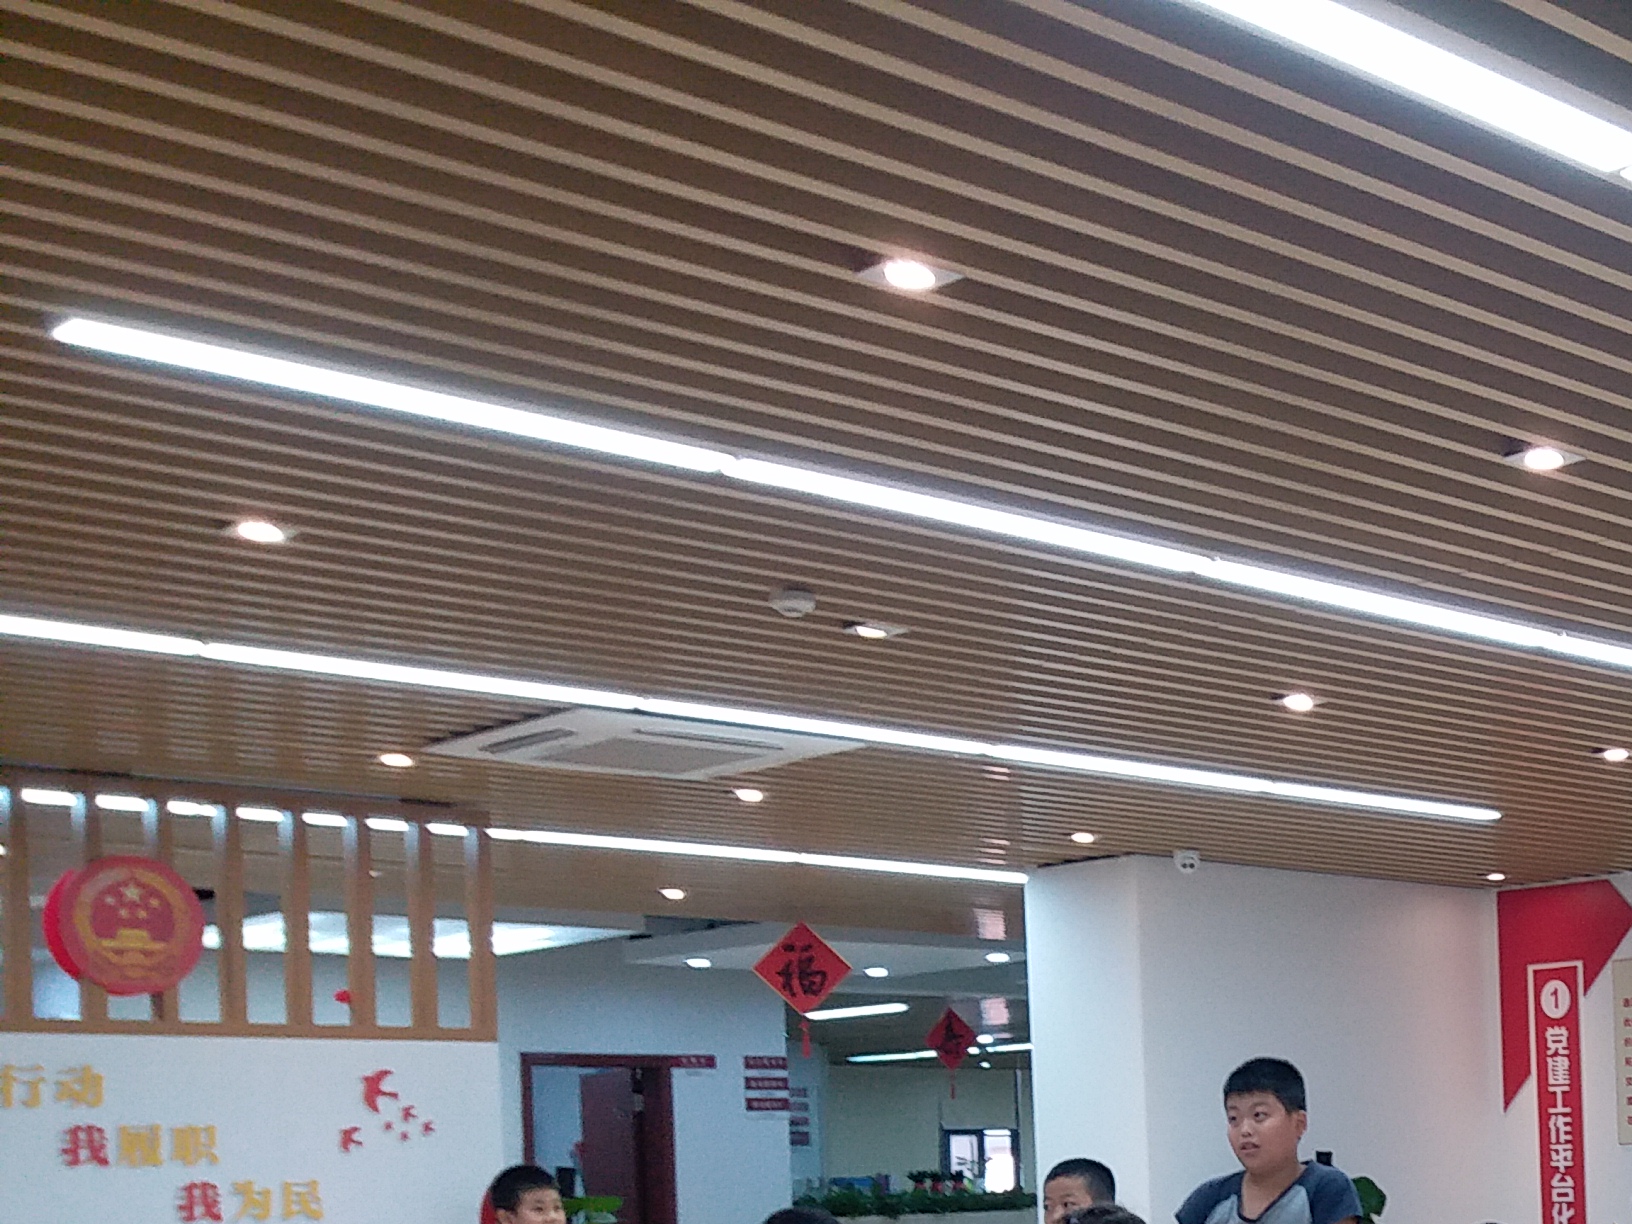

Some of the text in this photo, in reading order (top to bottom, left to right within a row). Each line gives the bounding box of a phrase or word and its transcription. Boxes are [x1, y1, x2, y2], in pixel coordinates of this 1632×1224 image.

[775, 944, 827, 998] 福
[0, 1064, 105, 1108] 行动
[61, 1124, 220, 1167] 我履职
[176, 1179, 324, 1223] 我为民
